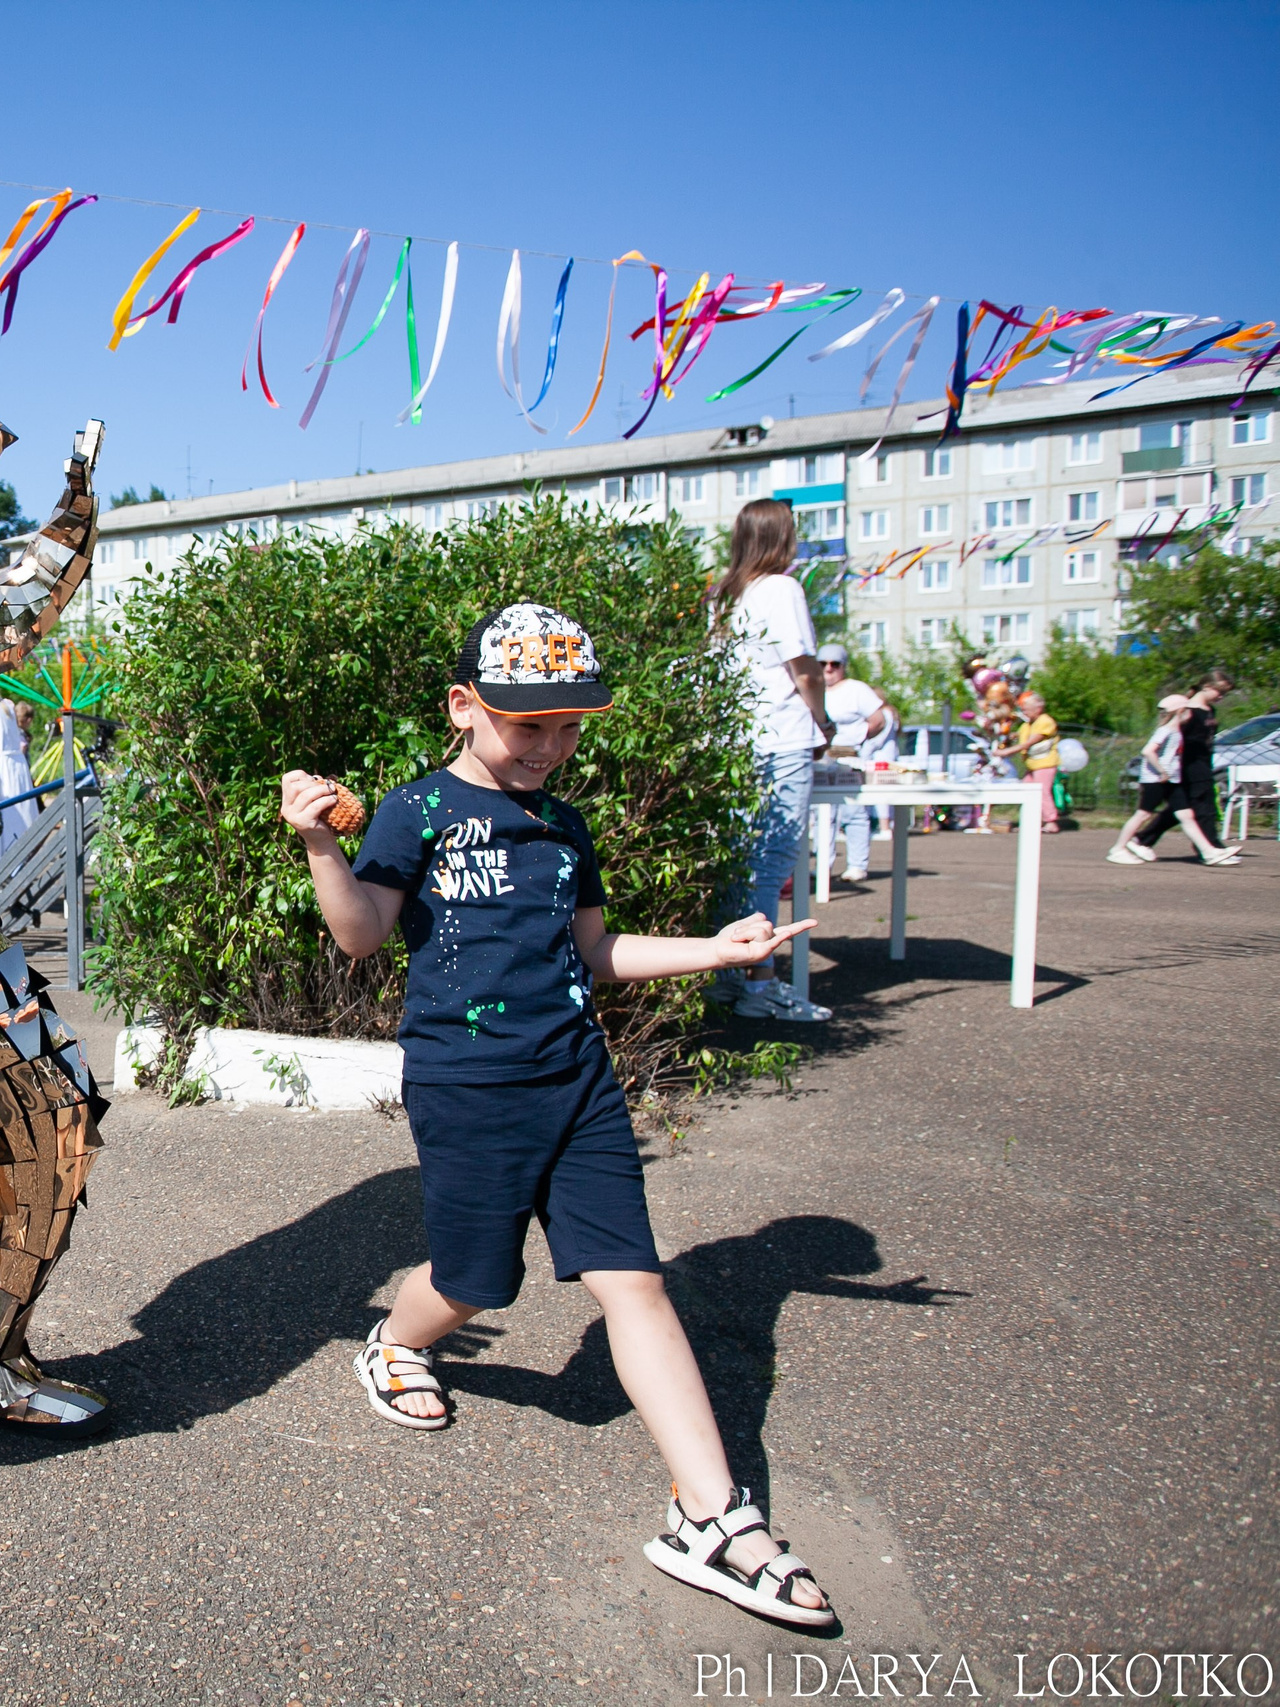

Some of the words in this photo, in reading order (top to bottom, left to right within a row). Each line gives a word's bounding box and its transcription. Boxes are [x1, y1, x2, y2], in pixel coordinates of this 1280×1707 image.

[501, 634, 585, 674] FREE
[446, 852, 466, 870] IN
[470, 849, 507, 868] THE
[432, 868, 514, 900] WAVE
